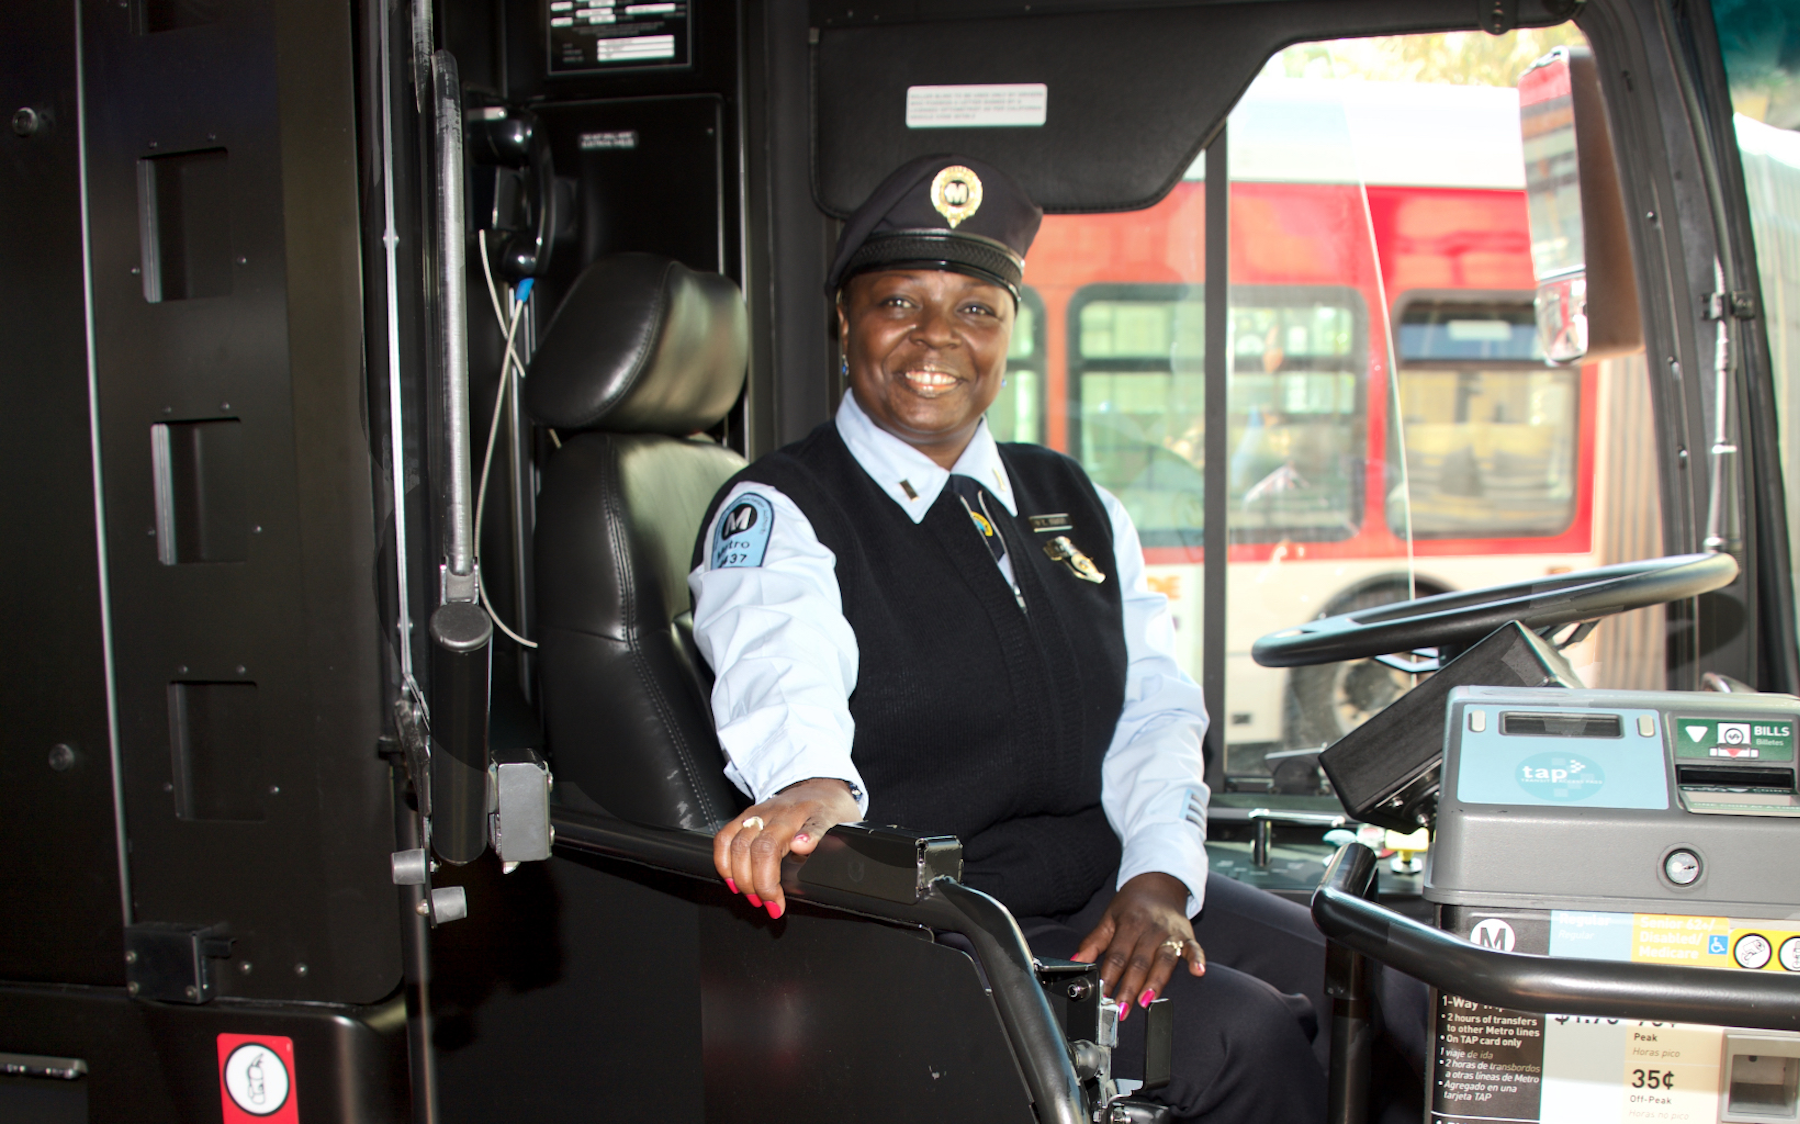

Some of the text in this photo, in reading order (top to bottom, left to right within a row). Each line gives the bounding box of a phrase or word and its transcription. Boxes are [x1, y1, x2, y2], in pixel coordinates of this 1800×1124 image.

[945, 182, 968, 205] M
[724, 507, 752, 537] M
[1753, 725, 1791, 737] BILLS
[1755, 738, 1784, 747] Billetes
[1522, 765, 1568, 784] tap
[1559, 913, 1612, 928] Regular
[1640, 916, 1716, 932] Senior 62+/
[1480, 927, 1506, 951] M
[1558, 930, 1595, 942] Regular
[1640, 931, 1704, 946] Disabled/
[1638, 946, 1699, 960] Medicare
[1442, 995, 1478, 1011] 1-Way
[1447, 1013, 1538, 1026] 2 hours of transfers
[1446, 1024, 1540, 1037] to other Metro lines
[1446, 1034, 1522, 1049] On TAP card only
[1633, 1032, 1658, 1043] Peak
[1445, 1048, 1466, 1059] viaje
[1466, 1050, 1478, 1059] de
[1480, 1051, 1494, 1060] ida
[1632, 1047, 1681, 1059] Horas pico
[1444, 1059, 1541, 1073] 2 horas de transbordos
[1451, 1071, 1474, 1080] otras
[1502, 1073, 1513, 1082] de
[1514, 1074, 1540, 1084] Metro
[1631, 1069, 1675, 1090] 35¢
[1443, 1080, 1517, 1093] Agregado en una
[1443, 1091, 1493, 1102] tarjeta TAP
[1629, 1094, 1673, 1105] Off-Peak
[1628, 1109, 1690, 1122] Horas no pico
